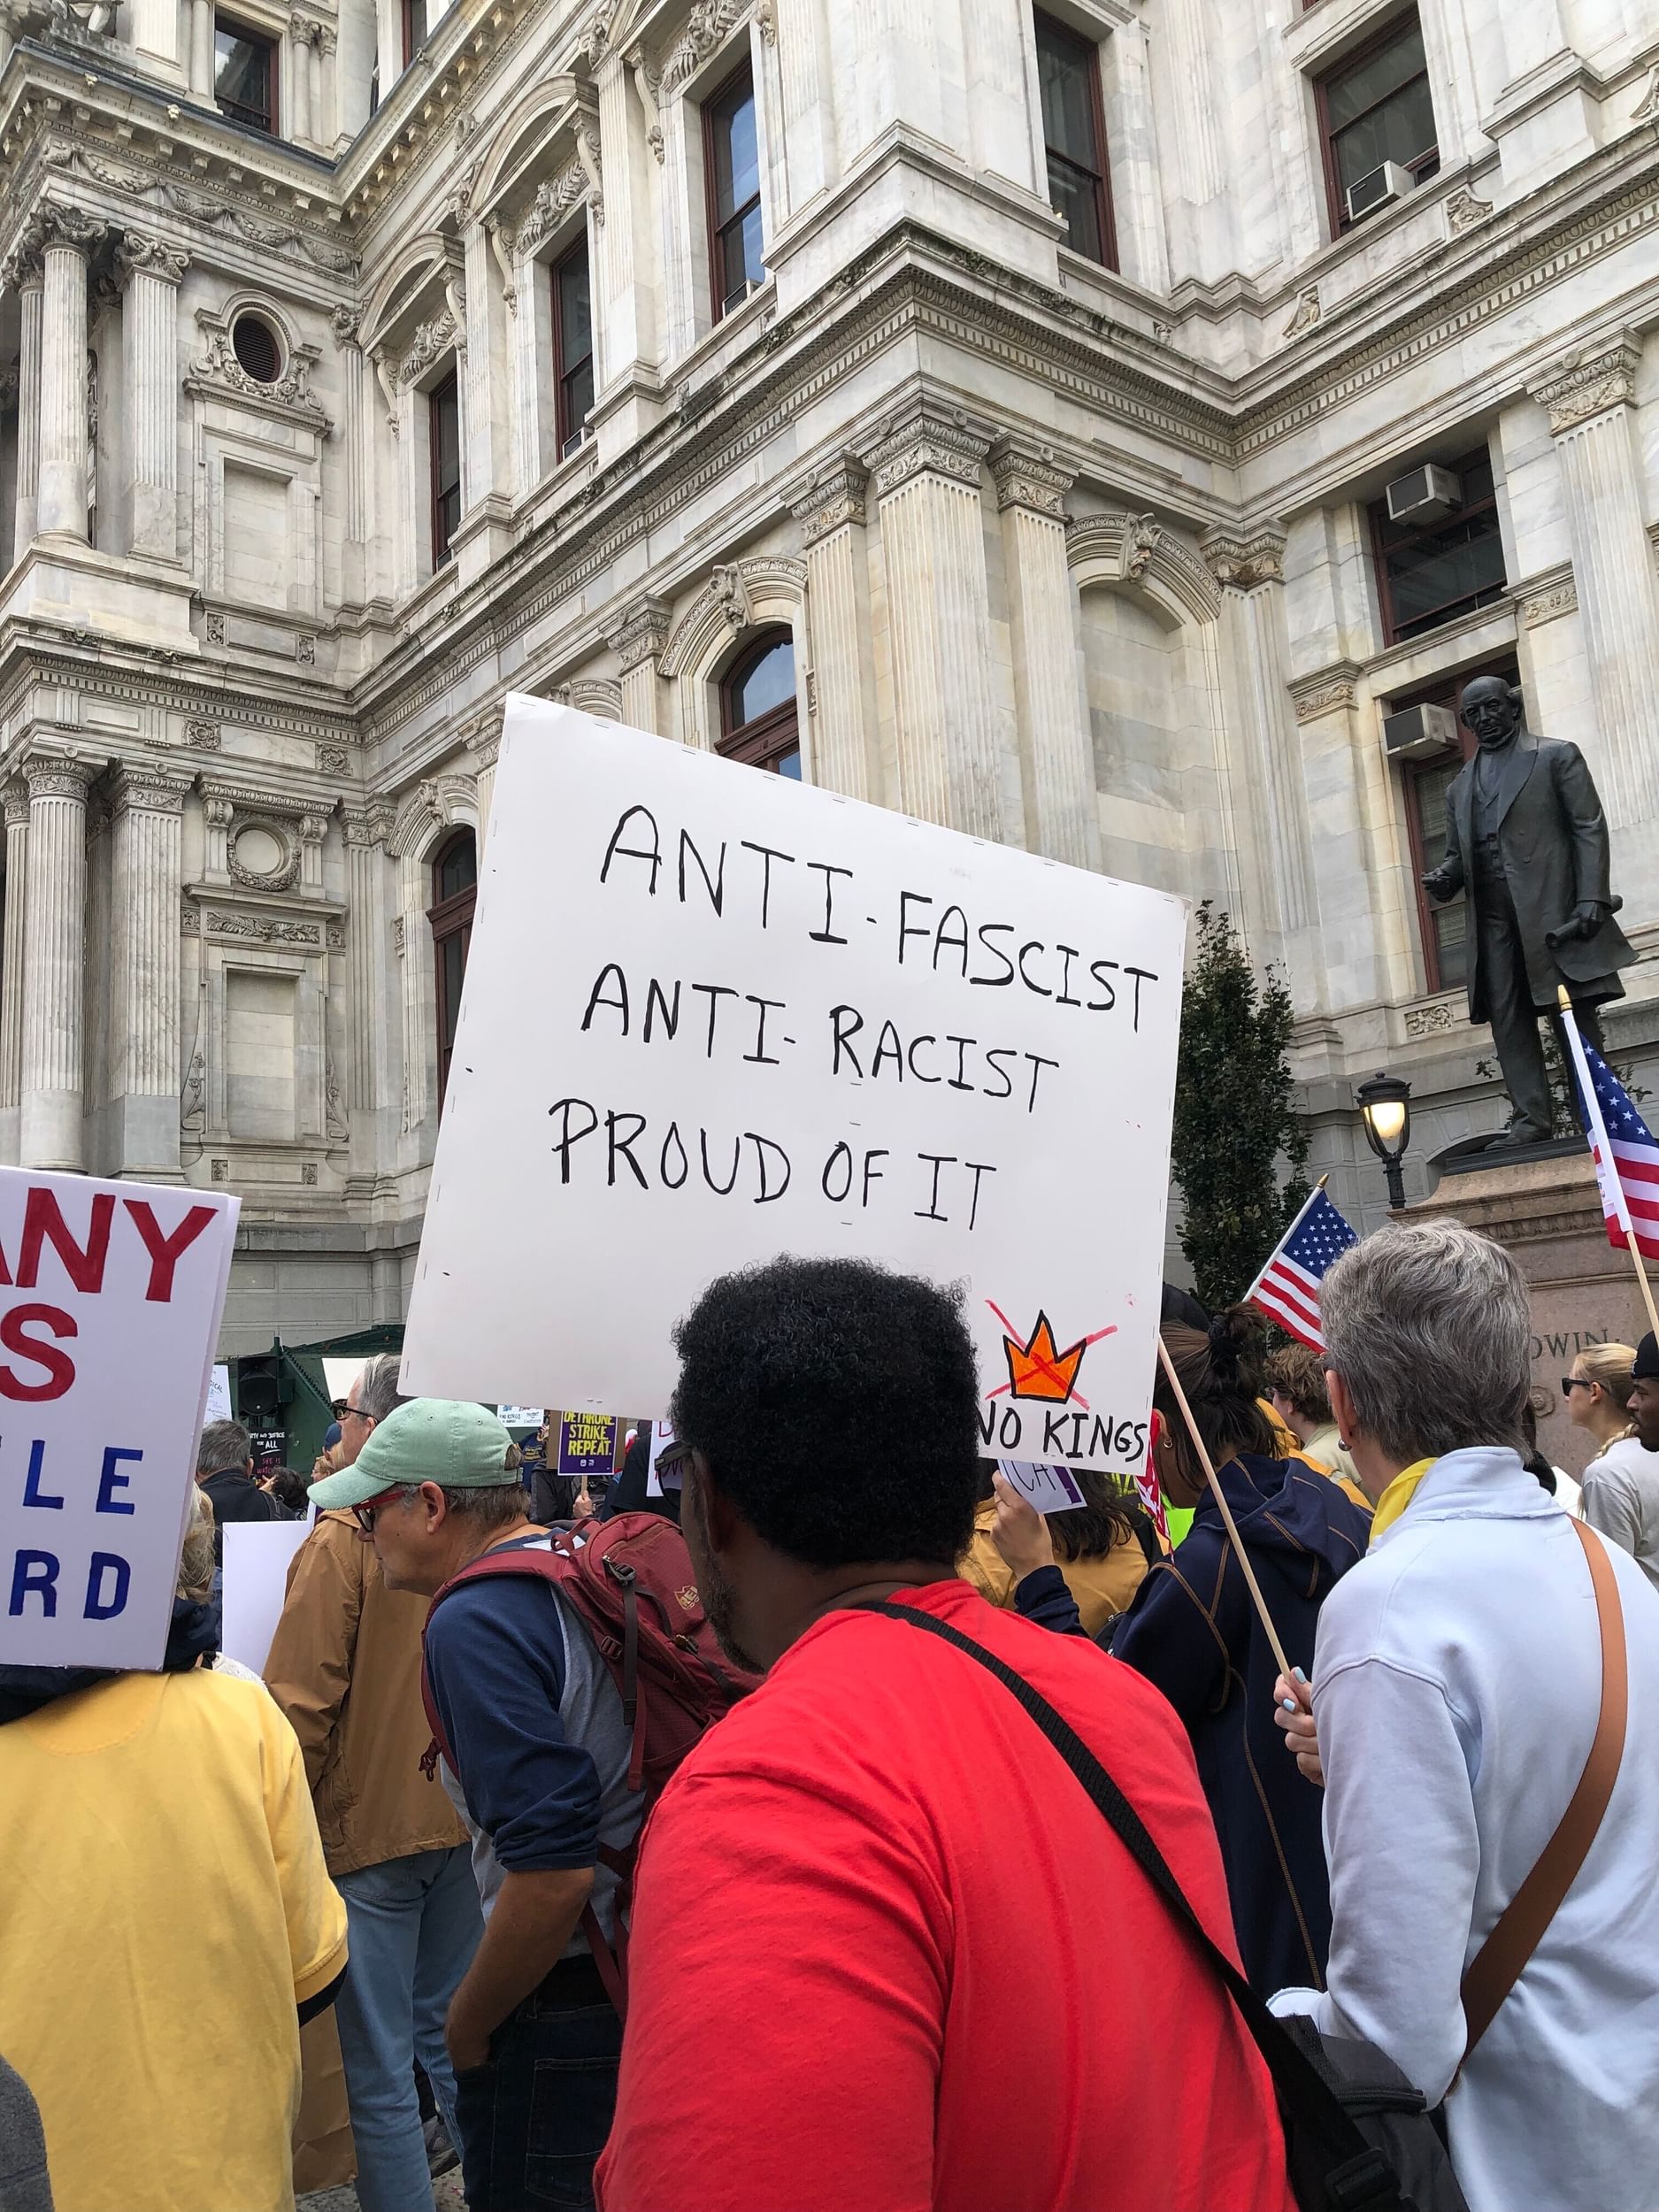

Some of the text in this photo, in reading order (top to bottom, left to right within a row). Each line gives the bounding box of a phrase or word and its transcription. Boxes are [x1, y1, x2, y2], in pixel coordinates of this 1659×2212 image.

[548, 1098, 997, 1231] PROUD OF IT
[0, 1187, 219, 1302] NY
[265, 1440, 278, 1450] ALL
[567, 1440, 612, 1456] REPEAT.
[976, 1400, 1148, 1463] NO KINGS
[0, 1435, 143, 1515] LE
